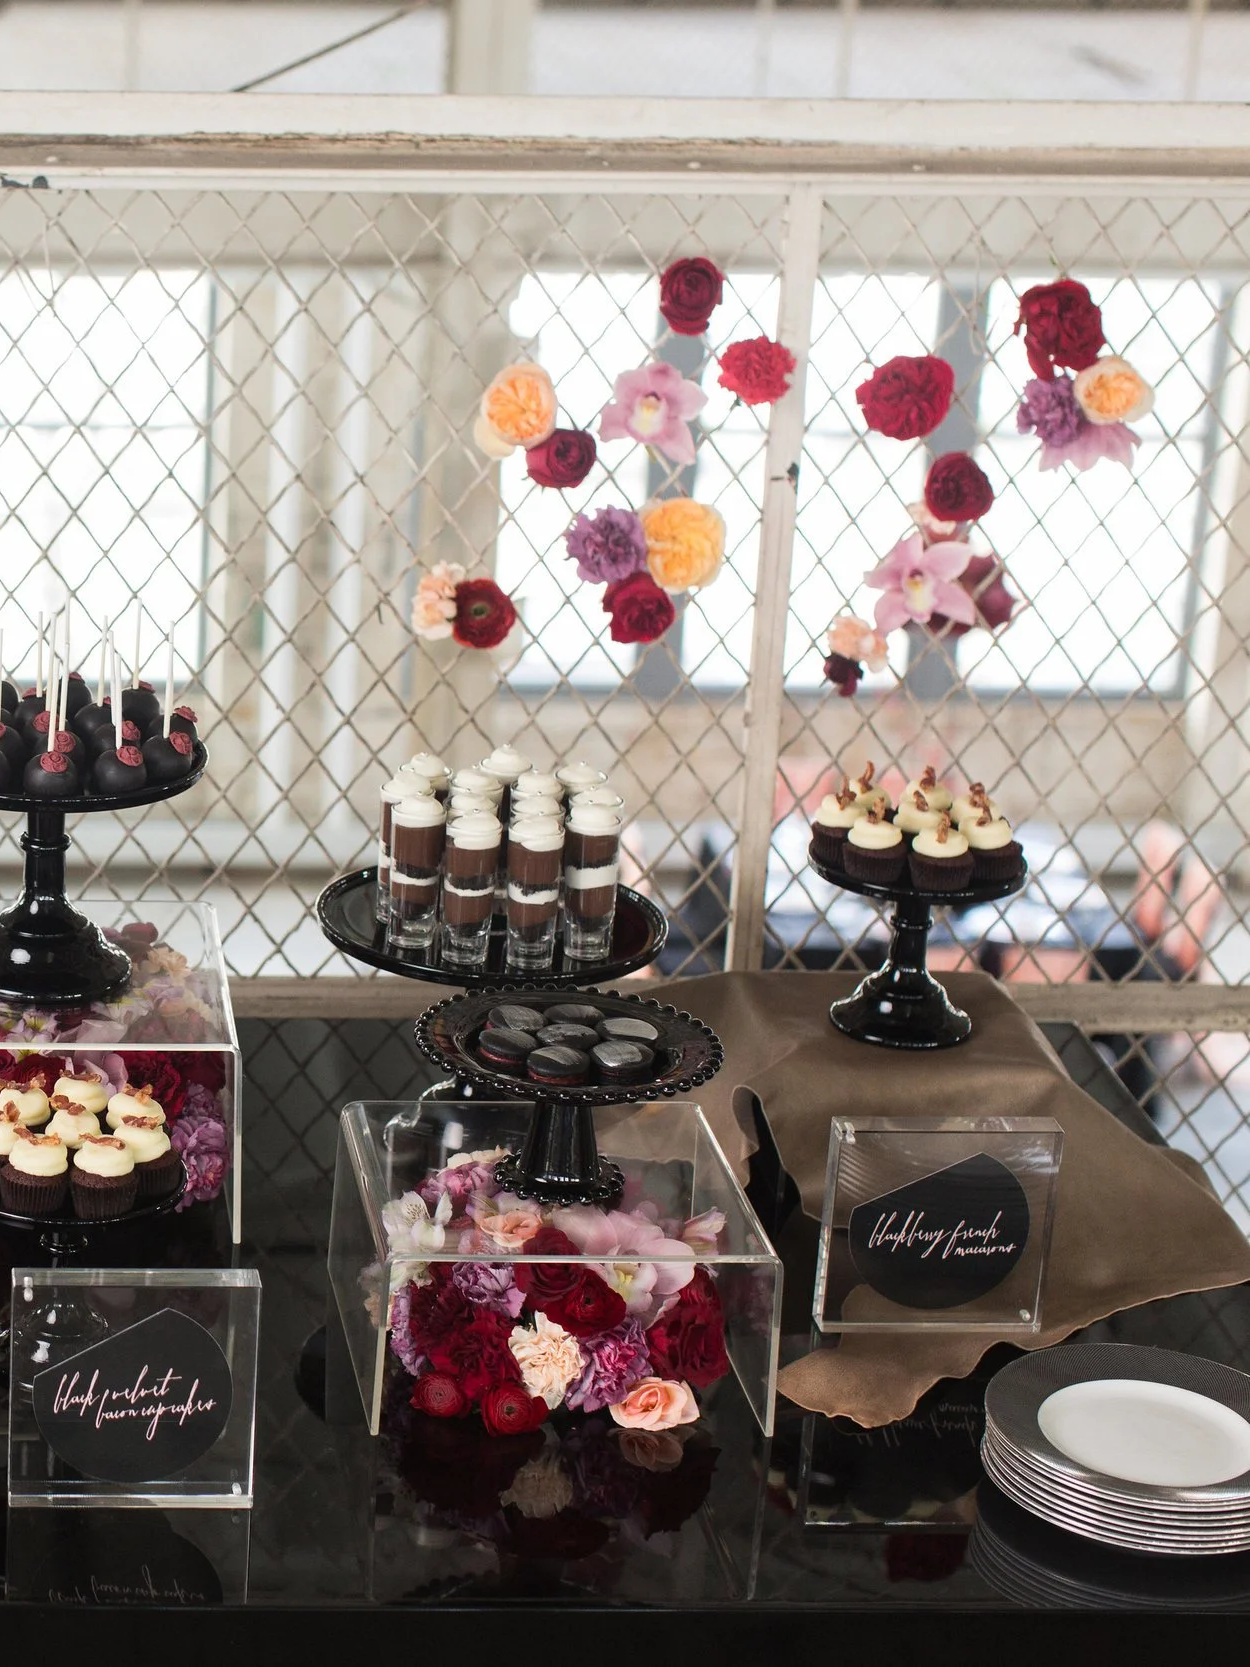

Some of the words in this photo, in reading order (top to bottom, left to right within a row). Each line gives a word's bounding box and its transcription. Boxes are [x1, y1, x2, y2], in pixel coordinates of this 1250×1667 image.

[868, 1210, 951, 1259] blackberry
[942, 1210, 1003, 1259] french
[954, 1242, 1017, 1257] macarons
[53, 1368, 100, 1417] black
[111, 1364, 183, 1404] velvet
[95, 1388, 139, 1429] bacon
[141, 1378, 217, 1441] cupcakes
